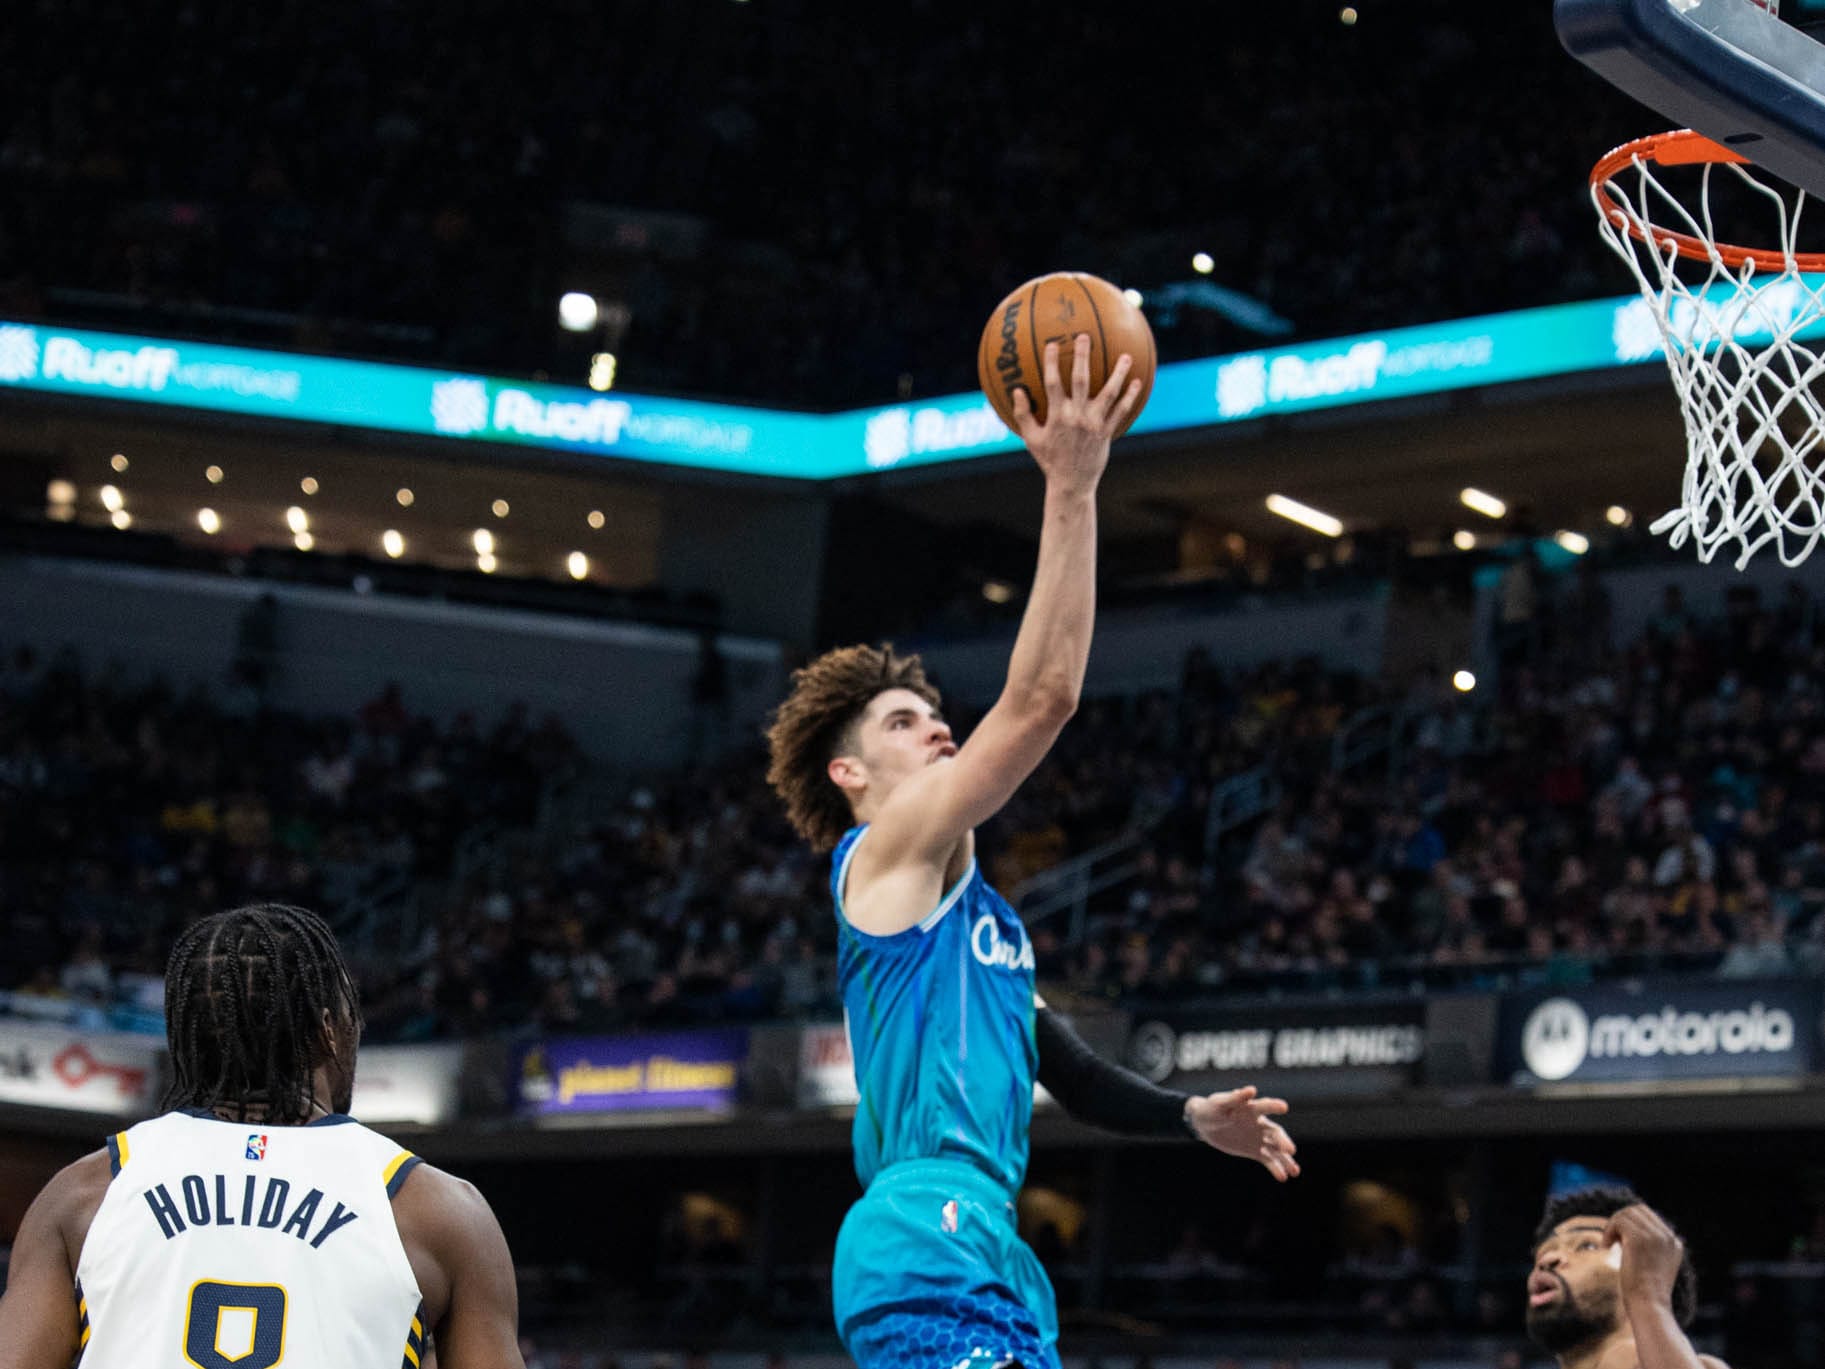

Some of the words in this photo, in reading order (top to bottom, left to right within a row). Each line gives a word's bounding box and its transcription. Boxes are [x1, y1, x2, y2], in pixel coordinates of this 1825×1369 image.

[43, 337, 178, 391] Ruoff
[1268, 339, 1387, 402] Ruoff
[493, 389, 632, 444] Ruoff
[911, 401, 1009, 453] Ruo
[1175, 1030, 1271, 1070] SPORT
[1273, 1025, 1423, 1067] GRAPHICS
[1590, 1002, 1795, 1058] motorola
[143, 1174, 359, 1250] HOLIDAY
